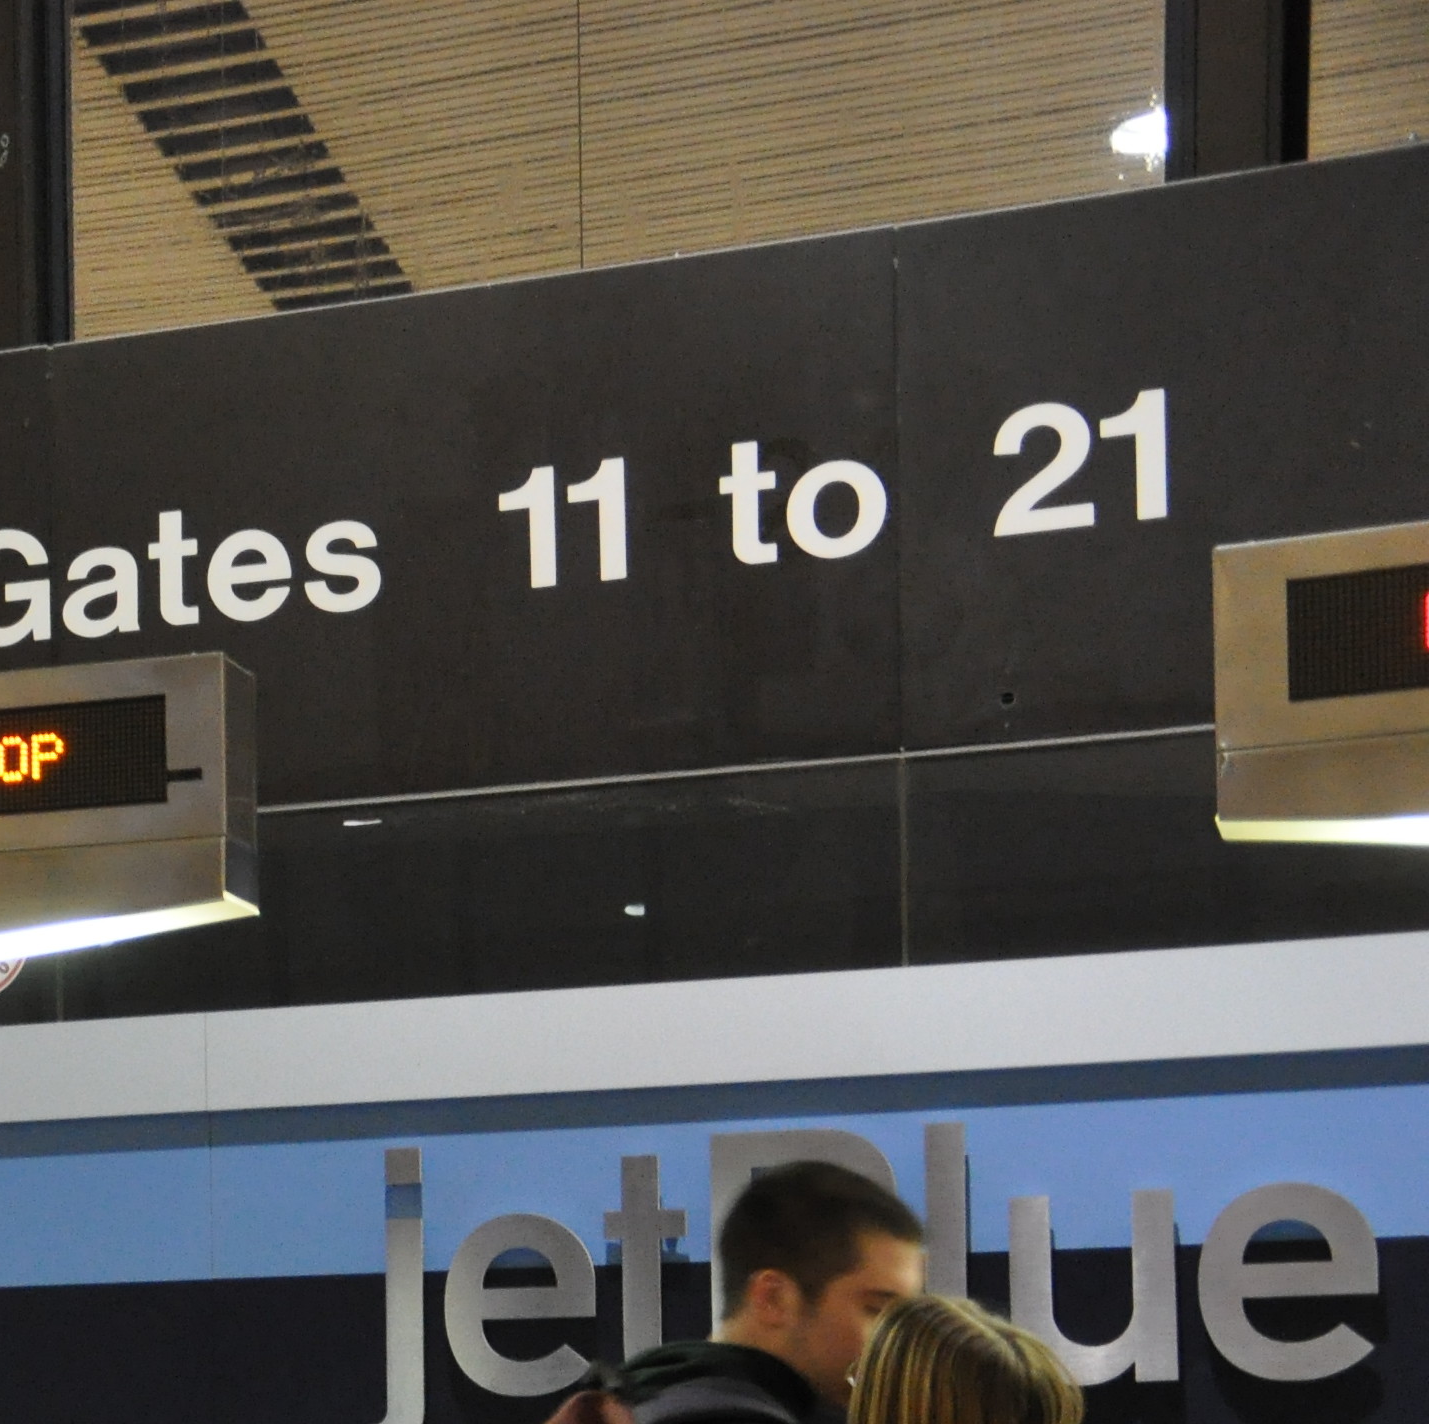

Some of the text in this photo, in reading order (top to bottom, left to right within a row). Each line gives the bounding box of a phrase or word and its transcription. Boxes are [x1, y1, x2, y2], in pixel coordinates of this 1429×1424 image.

[499, 457, 628, 589] 11
[719, 441, 887, 565] to
[994, 388, 1168, 538] 21
